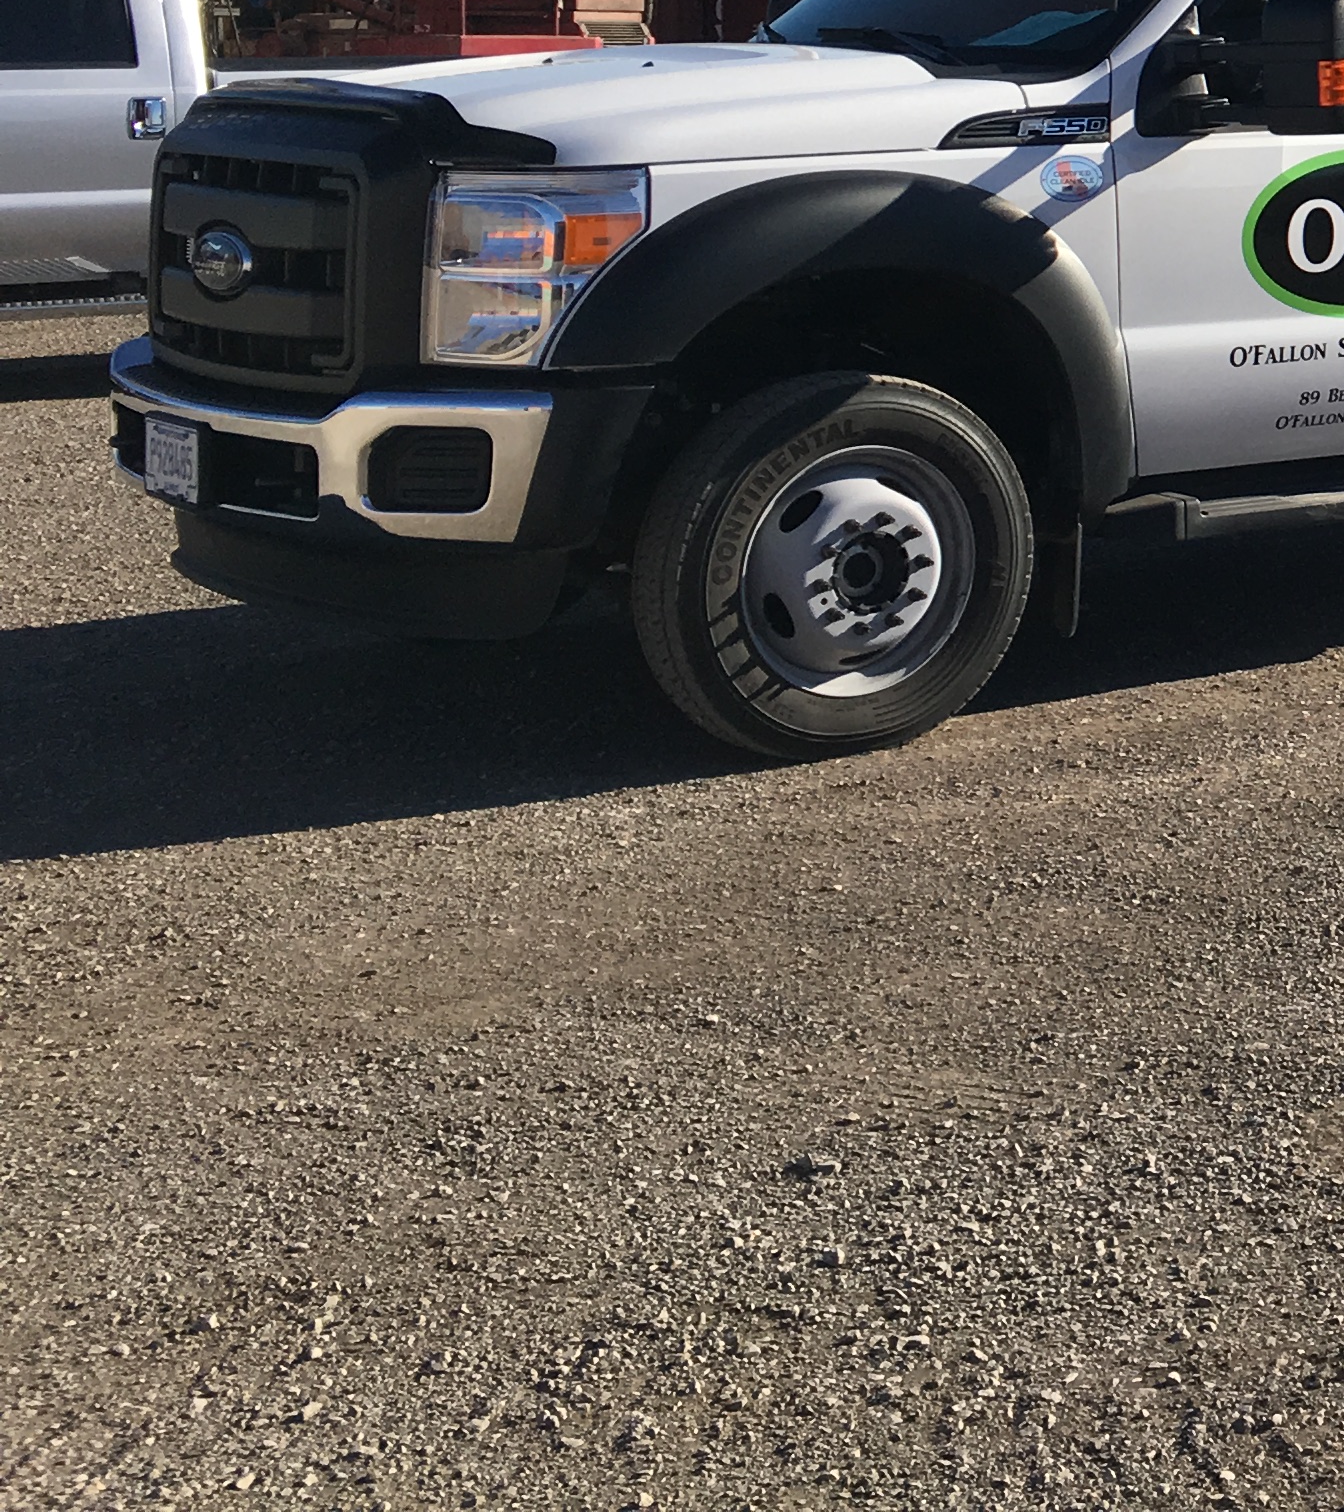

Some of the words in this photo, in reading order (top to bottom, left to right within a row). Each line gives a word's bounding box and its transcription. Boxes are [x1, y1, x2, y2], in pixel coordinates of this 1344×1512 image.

[1229, 343, 1327, 367] O'FALLON
[1299, 390, 1320, 405] 89
[711, 419, 867, 586] CONTINENTAL
